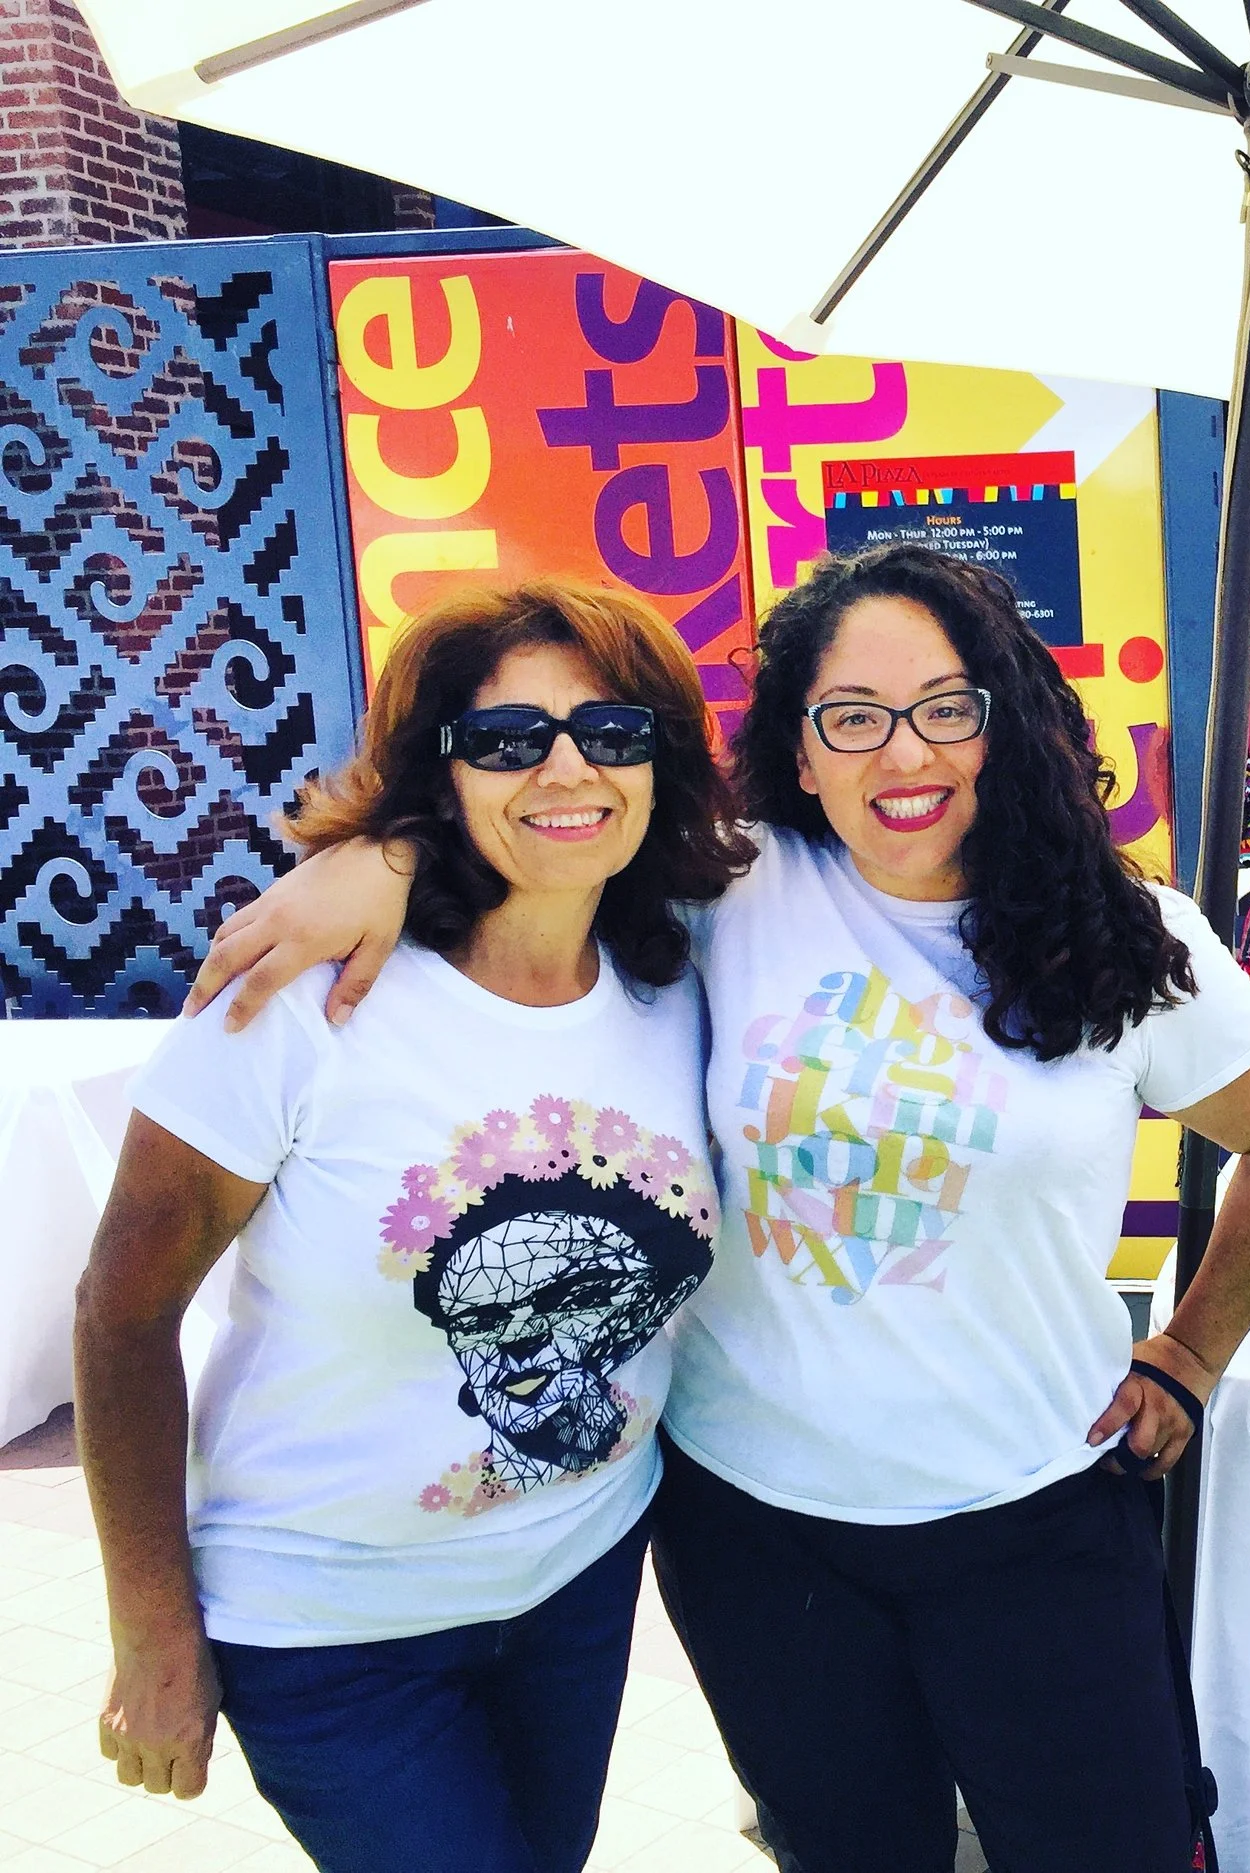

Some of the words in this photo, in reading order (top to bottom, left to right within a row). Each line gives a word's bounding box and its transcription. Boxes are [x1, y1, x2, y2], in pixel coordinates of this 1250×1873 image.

[825, 461, 857, 488] LA
[931, 527, 958, 538] 12:00
[960, 528, 975, 536] PM
[983, 525, 1006, 536] 5:00
[1008, 526, 1023, 535] PM
[976, 550, 999, 560] 6:00
[1002, 551, 1017, 560] PM
